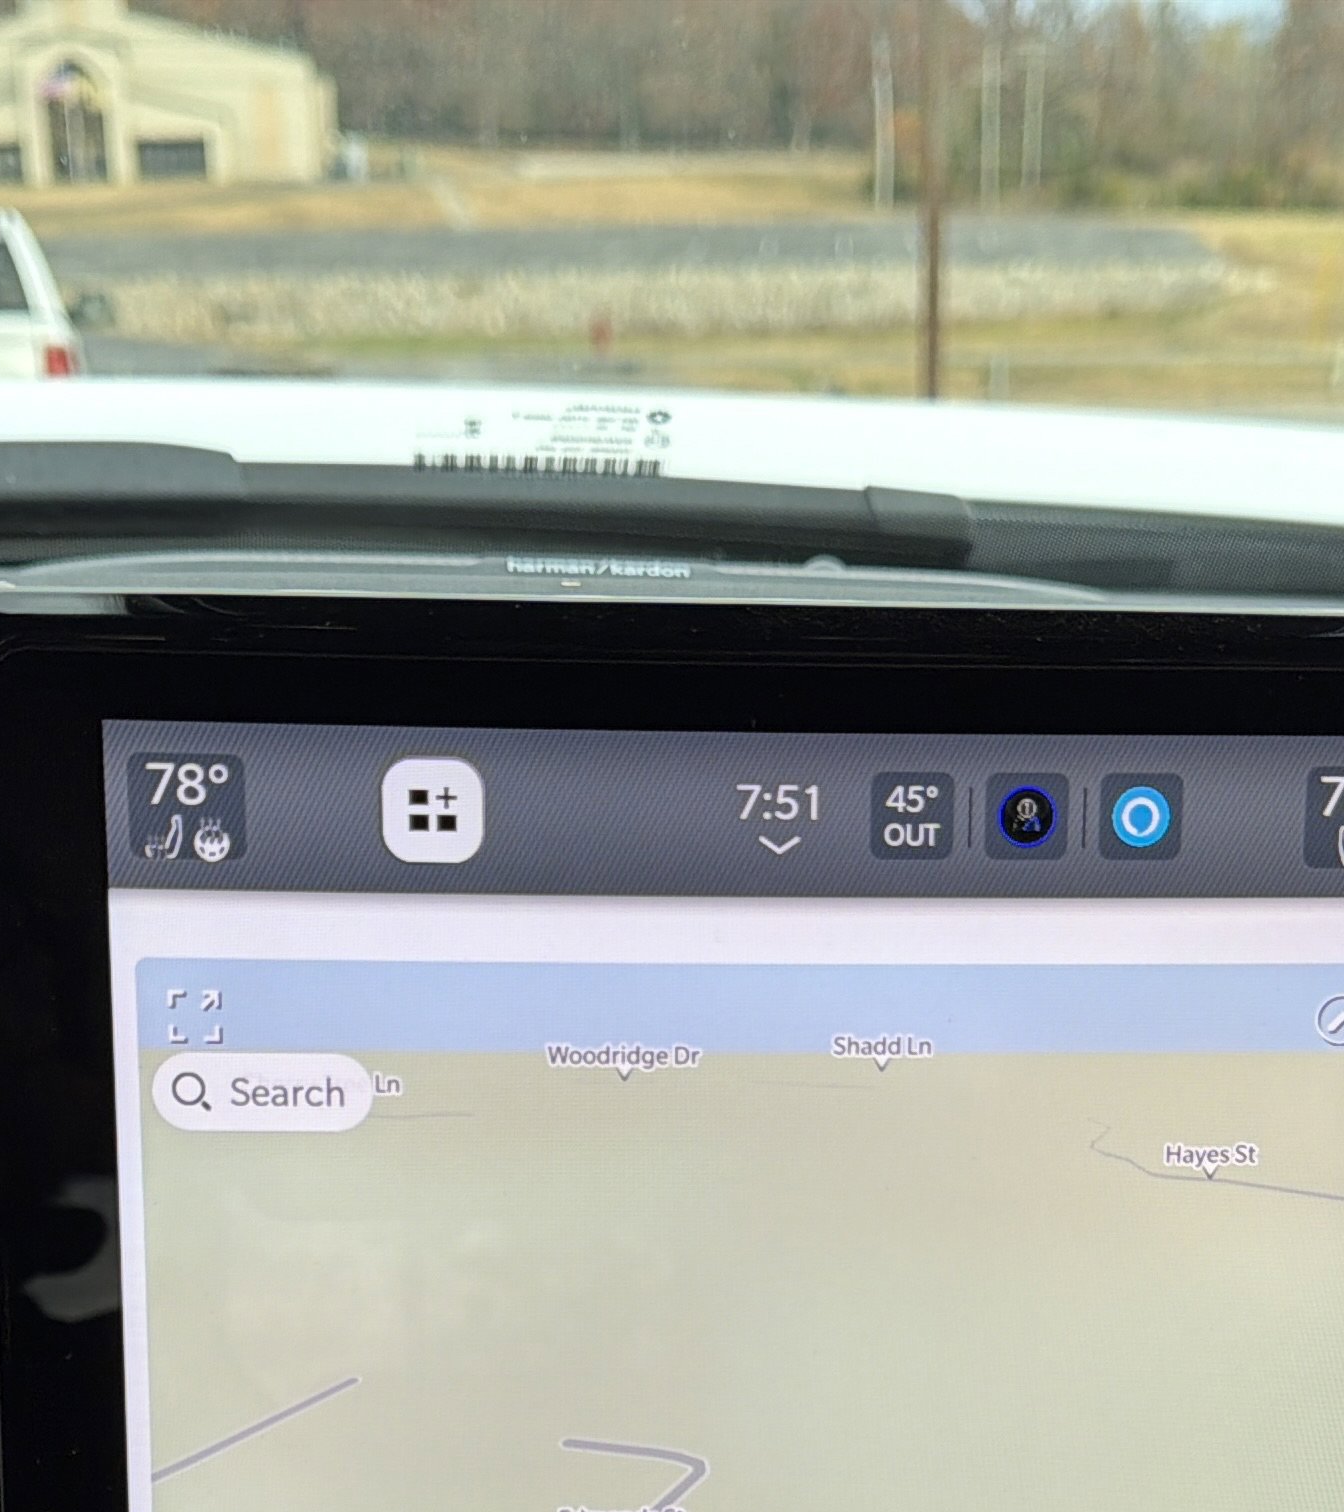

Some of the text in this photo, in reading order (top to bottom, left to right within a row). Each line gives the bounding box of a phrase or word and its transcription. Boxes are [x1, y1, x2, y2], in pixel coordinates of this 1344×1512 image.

[506, 556, 692, 578] harman/kardon
[736, 784, 819, 821] 7:51
[885, 785, 939, 813] 45°
[883, 822, 941, 847] OUT
[547, 1044, 700, 1069] Woodridge Dr
[832, 1035, 932, 1057] Shadd Ln
[230, 1076, 345, 1108] Search
[374, 1074, 401, 1094] Ln
[1165, 1144, 1257, 1169] Hayes St
